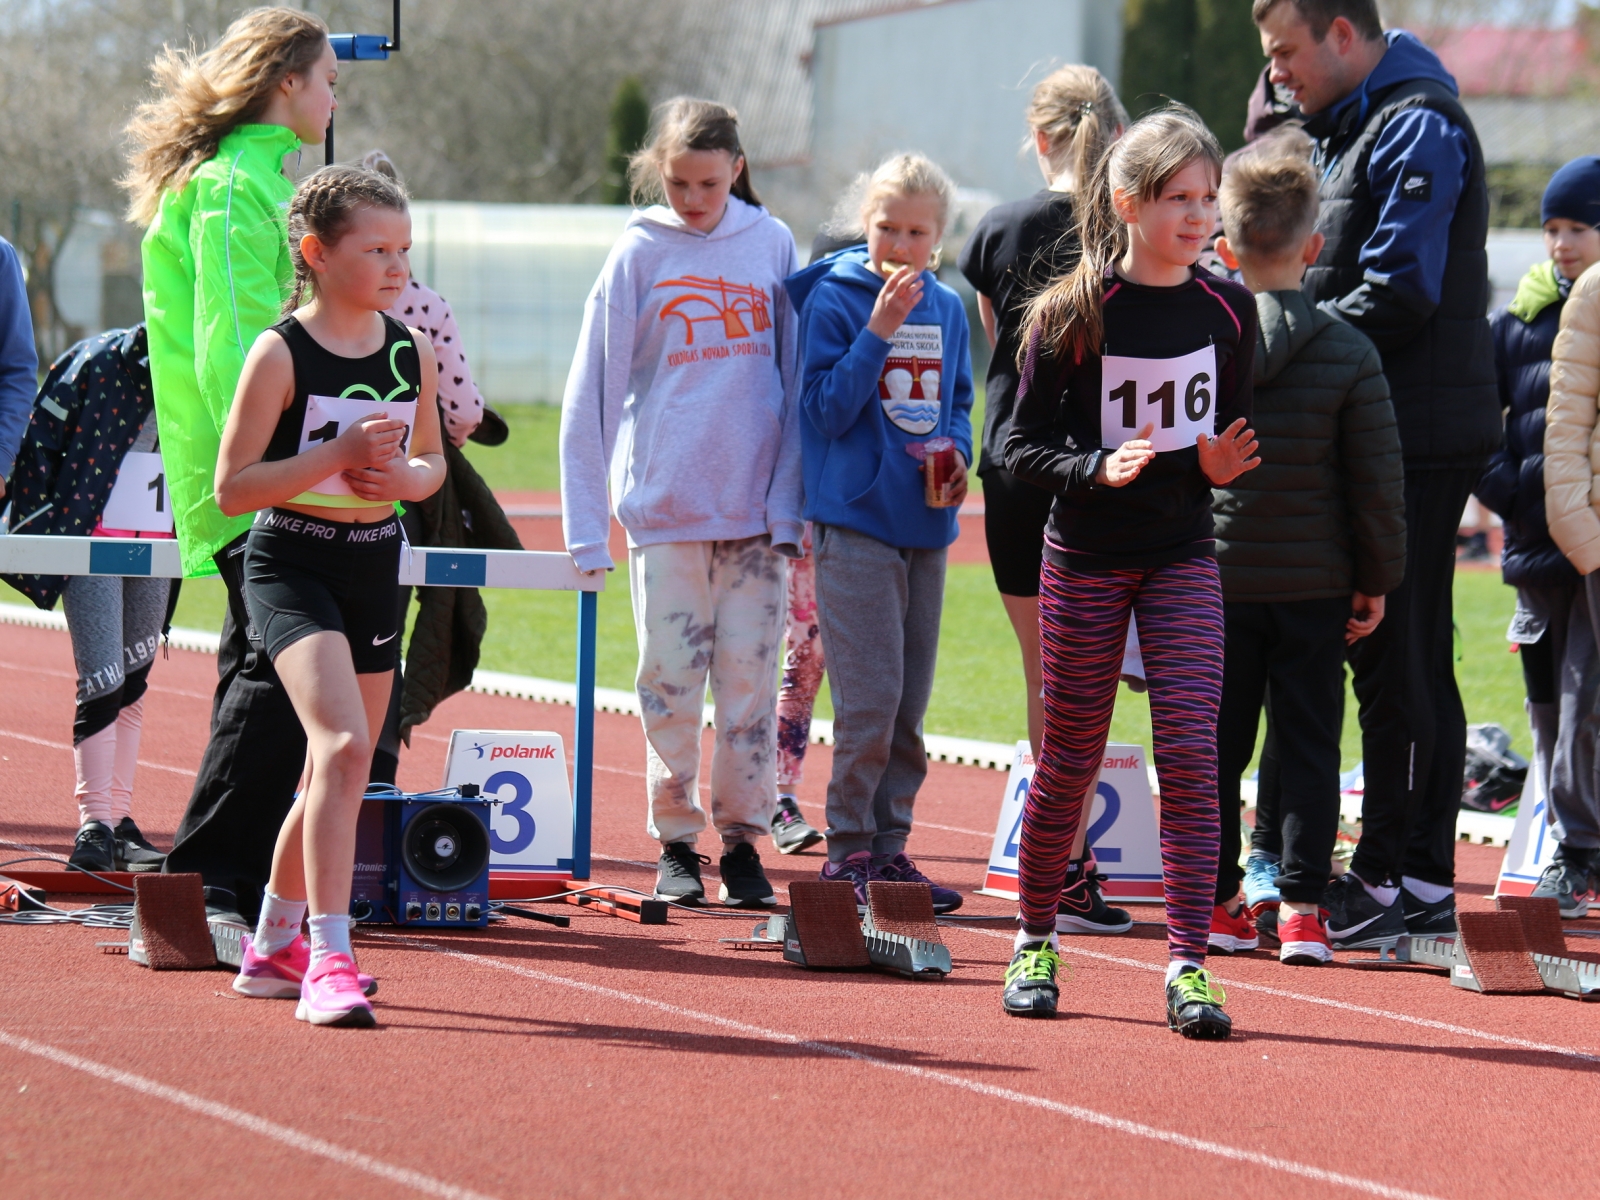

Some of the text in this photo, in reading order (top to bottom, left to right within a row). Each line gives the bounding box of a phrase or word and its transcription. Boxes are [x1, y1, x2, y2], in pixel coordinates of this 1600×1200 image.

[702, 346, 731, 360] NOVADA
[732, 342, 759, 357] SPORTA
[894, 341, 941, 352] ORTA SKOLA
[1108, 371, 1211, 429] 116
[264, 512, 303, 533] NIKE
[302, 522, 337, 540] PRO
[347, 522, 397, 543] NIKE PRO
[489, 743, 557, 762] polanik
[1103, 755, 1140, 769] anik
[482, 770, 536, 855] 3
[1003, 777, 1029, 858] 2
[1086, 780, 1122, 863] 2
